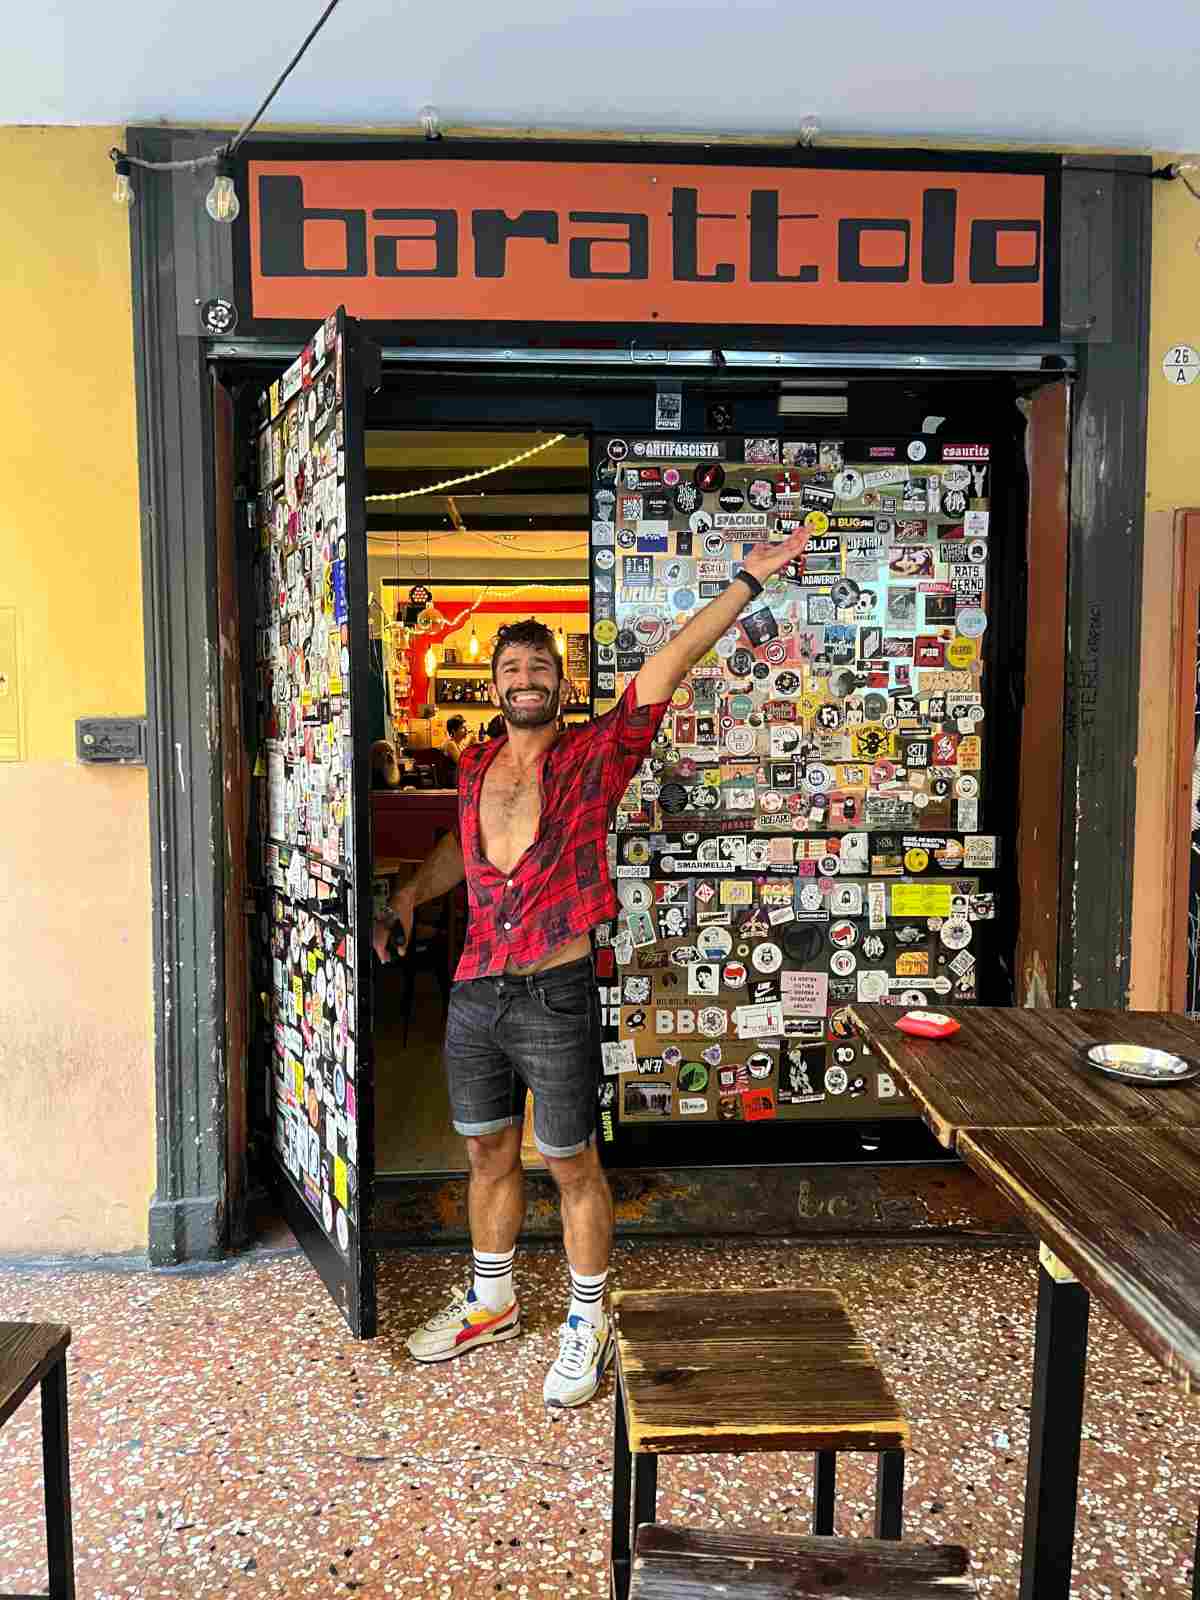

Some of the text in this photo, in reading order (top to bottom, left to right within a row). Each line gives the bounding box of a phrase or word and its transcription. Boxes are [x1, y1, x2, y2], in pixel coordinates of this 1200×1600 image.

[259, 175, 1042, 284] barattolo
[1175, 348, 1189, 363] 26
[1176, 368, 1186, 382] A
[763, 896, 791, 905] NZS
